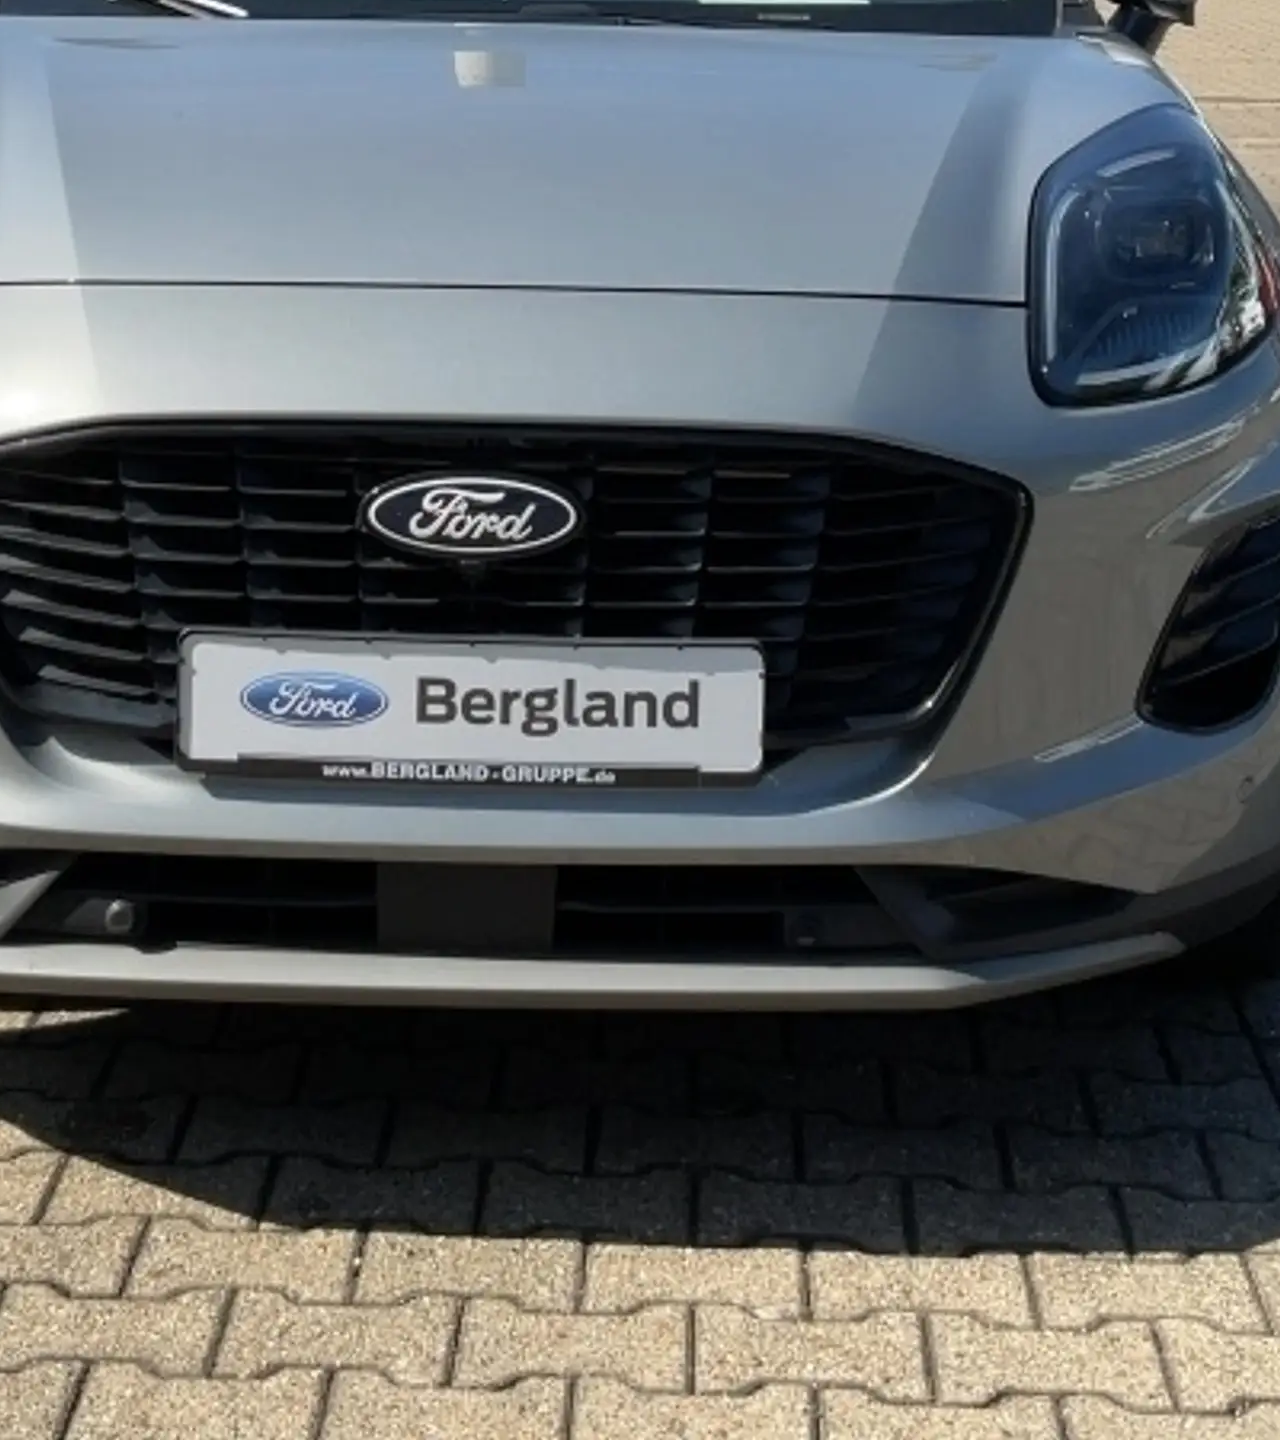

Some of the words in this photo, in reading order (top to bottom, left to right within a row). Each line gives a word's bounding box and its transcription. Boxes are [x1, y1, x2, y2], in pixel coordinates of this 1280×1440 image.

[408, 485, 536, 542] Ford
[267, 680, 360, 719] Ford
[416, 677, 701, 737] Bergland
[321, 760, 617, 785] www.BERGLAND-GRUPPE.de
